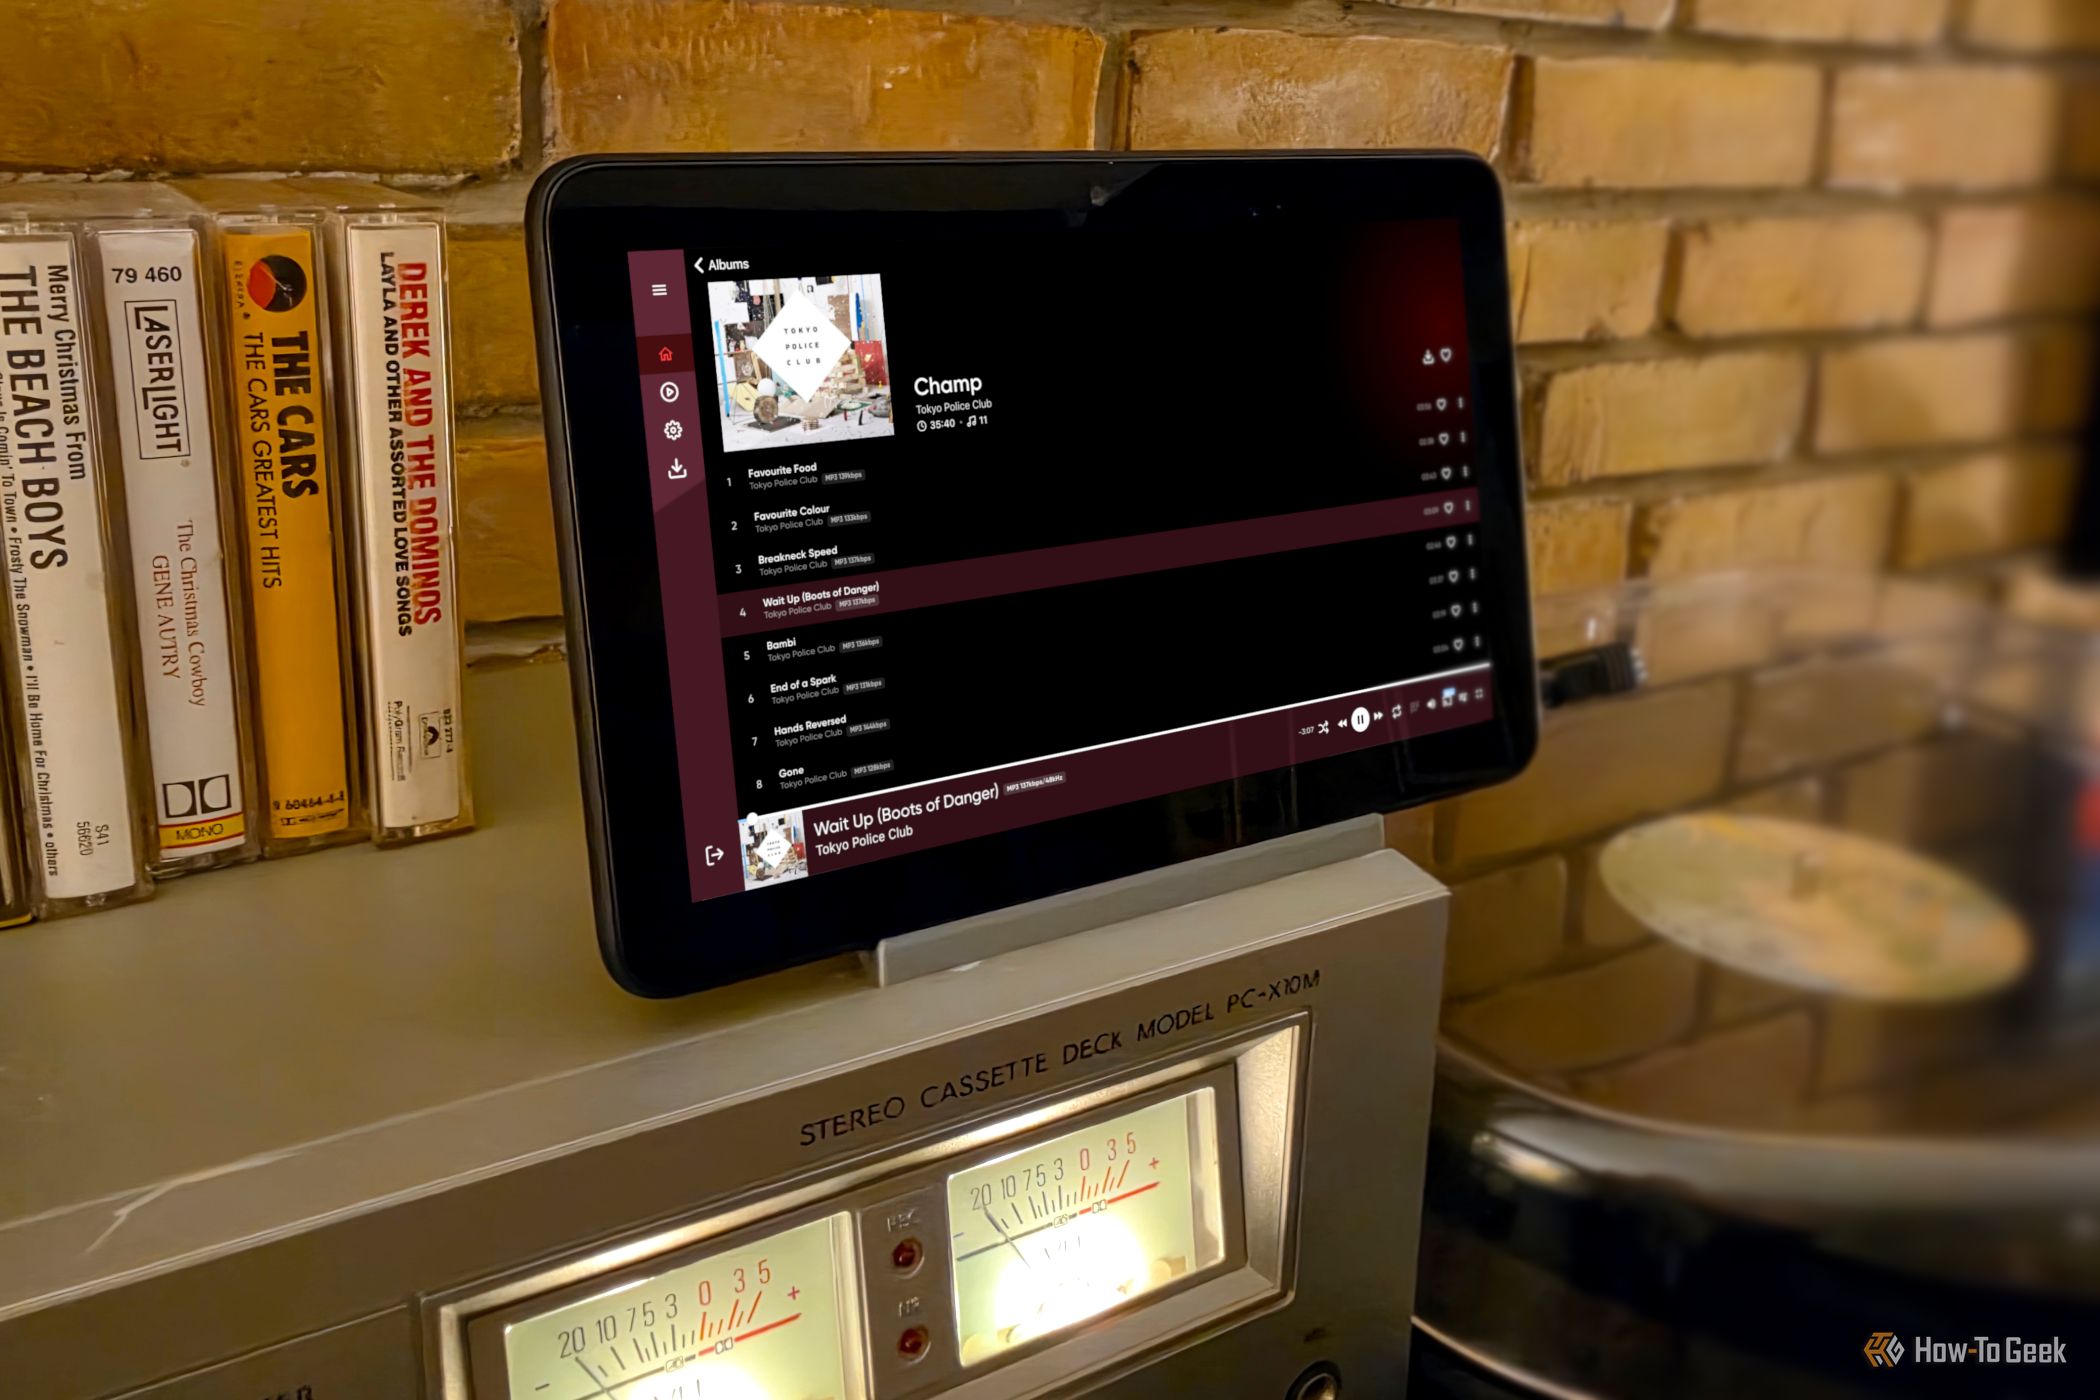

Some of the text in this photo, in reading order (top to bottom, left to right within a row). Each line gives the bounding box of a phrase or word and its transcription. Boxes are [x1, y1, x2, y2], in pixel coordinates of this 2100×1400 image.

[708, 258, 749, 271] Albums
[111, 265, 183, 284] 79 460
[783, 326, 818, 334] TOKYO
[785, 341, 819, 350] POLICE
[787, 357, 821, 366] CLUB
[47, 265, 86, 481] Merry Christmas From
[133, 305, 184, 452] LASERLIGHT
[914, 376, 983, 396] Champ
[271, 330, 319, 498] THE CARS
[915, 399, 992, 415] Tokyo Police Club
[0, 265, 69, 570] THE BEACH BOYS
[930, 419, 956, 429] 35:40
[979, 416, 988, 425] 11
[380, 251, 412, 637] LAYLA AND OTHER ASSORTED LOVE SONGS
[397, 262, 442, 626] DEREK AND THE DOMINOS
[243, 331, 282, 589] THE CARS GREATEST HITS
[748, 462, 817, 478] Favourite Food
[1, 473, 15, 487] To
[727, 478, 732, 487] 1
[750, 475, 818, 490] Tokyo Police Club
[3, 491, 17, 522] Town
[754, 505, 830, 521] Favourite Colour
[731, 521, 738, 530] 2
[755, 518, 823, 533] Tokyo Police Club
[6, 537, 23, 573] Frosty
[758, 545, 838, 565] Breakneck Speed
[735, 564, 742, 574] 3
[759, 561, 828, 577] Tokyo Police Club
[14, 577, 27, 599] The
[762, 581, 879, 607] Wait Up (Boots of Danger)
[151, 555, 181, 680] GENE AUTRY
[176, 520, 206, 707] The Christmas Cowboy
[739, 608, 746, 617] 4
[764, 603, 832, 619] Tokyo Police Club
[16, 604, 33, 662] Snowman
[767, 637, 796, 650] Bambi
[768, 644, 835, 662] Tokyo Police Club
[744, 651, 750, 661] 5
[770, 674, 837, 693] End of a Spark
[748, 694, 754, 703] 6
[772, 687, 839, 704] Tokyo Police Club
[29, 713, 44, 746] Home
[774, 714, 846, 736] Hands Reversed
[1299, 726, 1314, 735] -3:07
[752, 737, 758, 746] 7
[776, 728, 843, 747] Tokyo Police Club
[779, 766, 804, 778] Gone
[780, 770, 847, 789] Tokyo Police Club
[756, 780, 762, 789] 8
[36, 772, 53, 830] Christmas
[813, 783, 999, 837] Wait Up (Boots of Danger)
[76, 820, 94, 856] 56620
[175, 822, 224, 841] MONO
[816, 825, 913, 857] Tokyo Police Club
[45, 841, 58, 876] others
[800, 970, 1321, 1146] STEREO CASSETTE DECK MODEL PC-X10M
[970, 1132, 1136, 1210] 20 10 7 5 3 0 3 5
[558, 1259, 770, 1359] 20 10 7 5 3 0 3 5
